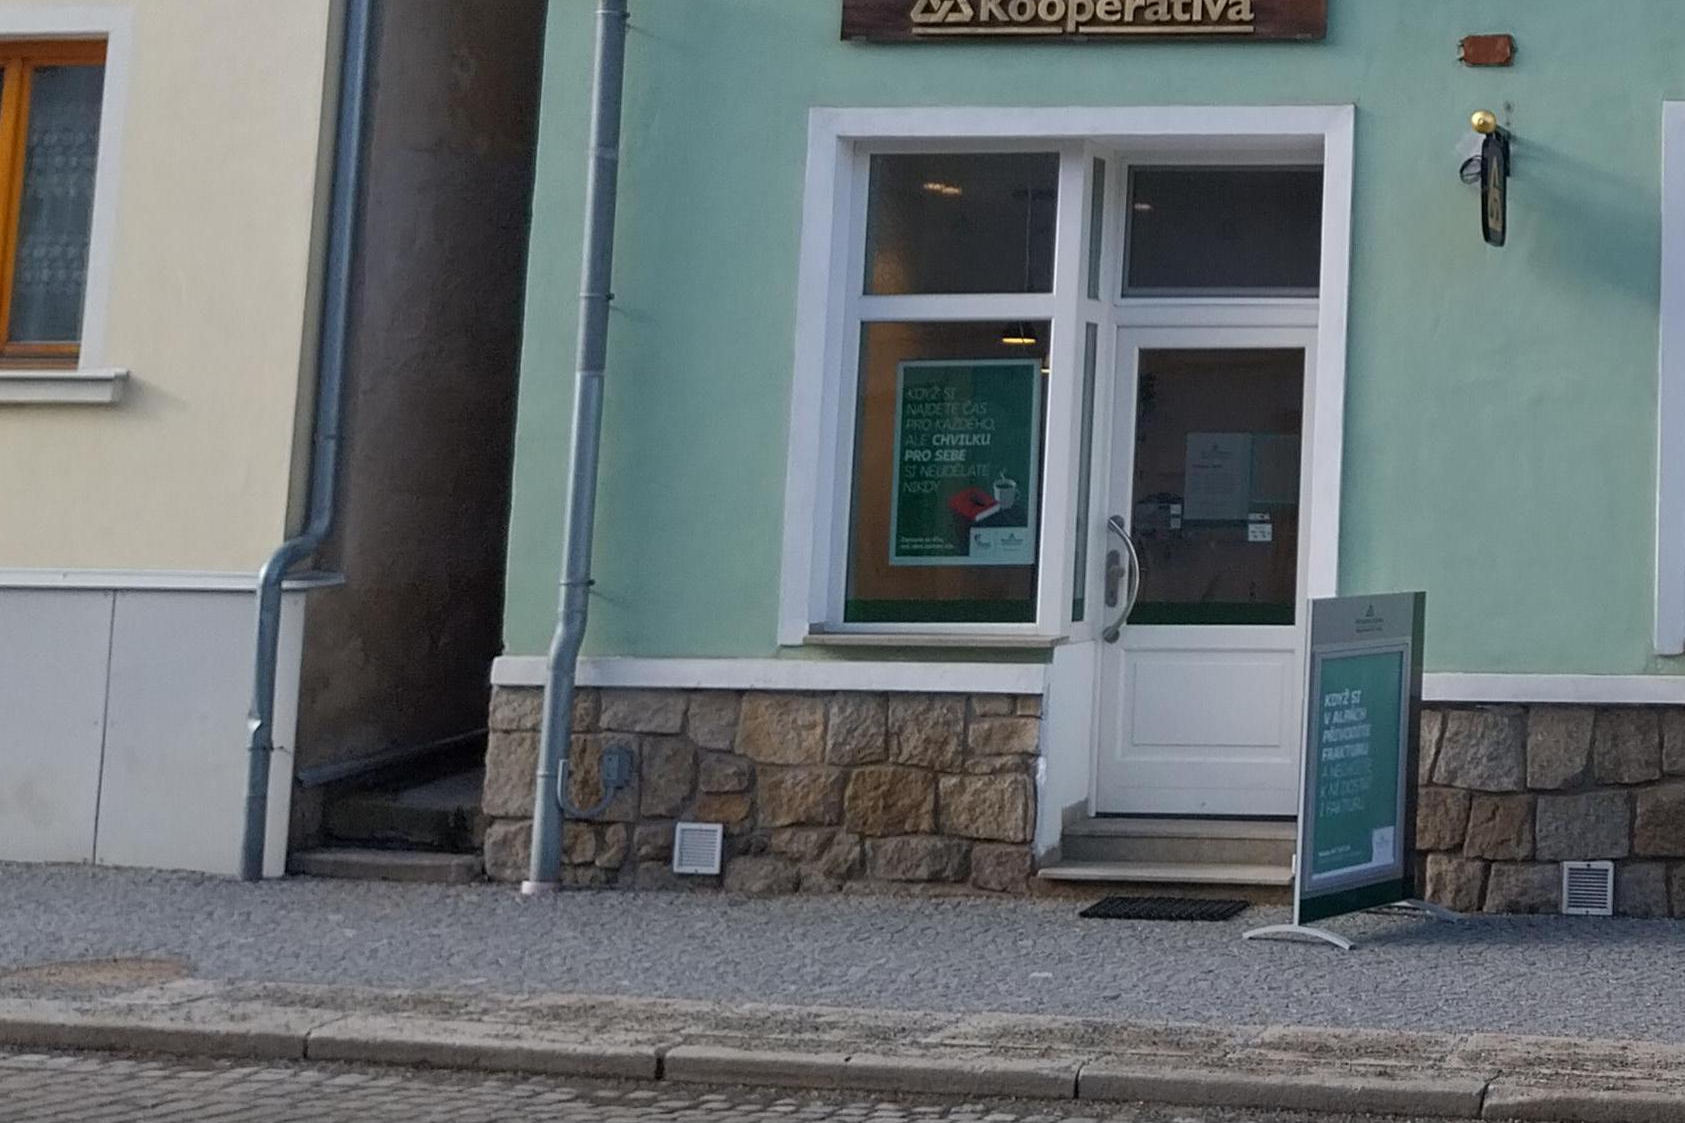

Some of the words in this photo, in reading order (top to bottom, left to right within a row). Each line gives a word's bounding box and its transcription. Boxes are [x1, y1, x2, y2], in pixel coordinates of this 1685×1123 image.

[932, 433, 992, 446] CHVILKU
[904, 449, 932, 462] PRO
[934, 449, 968, 462] SEBE
